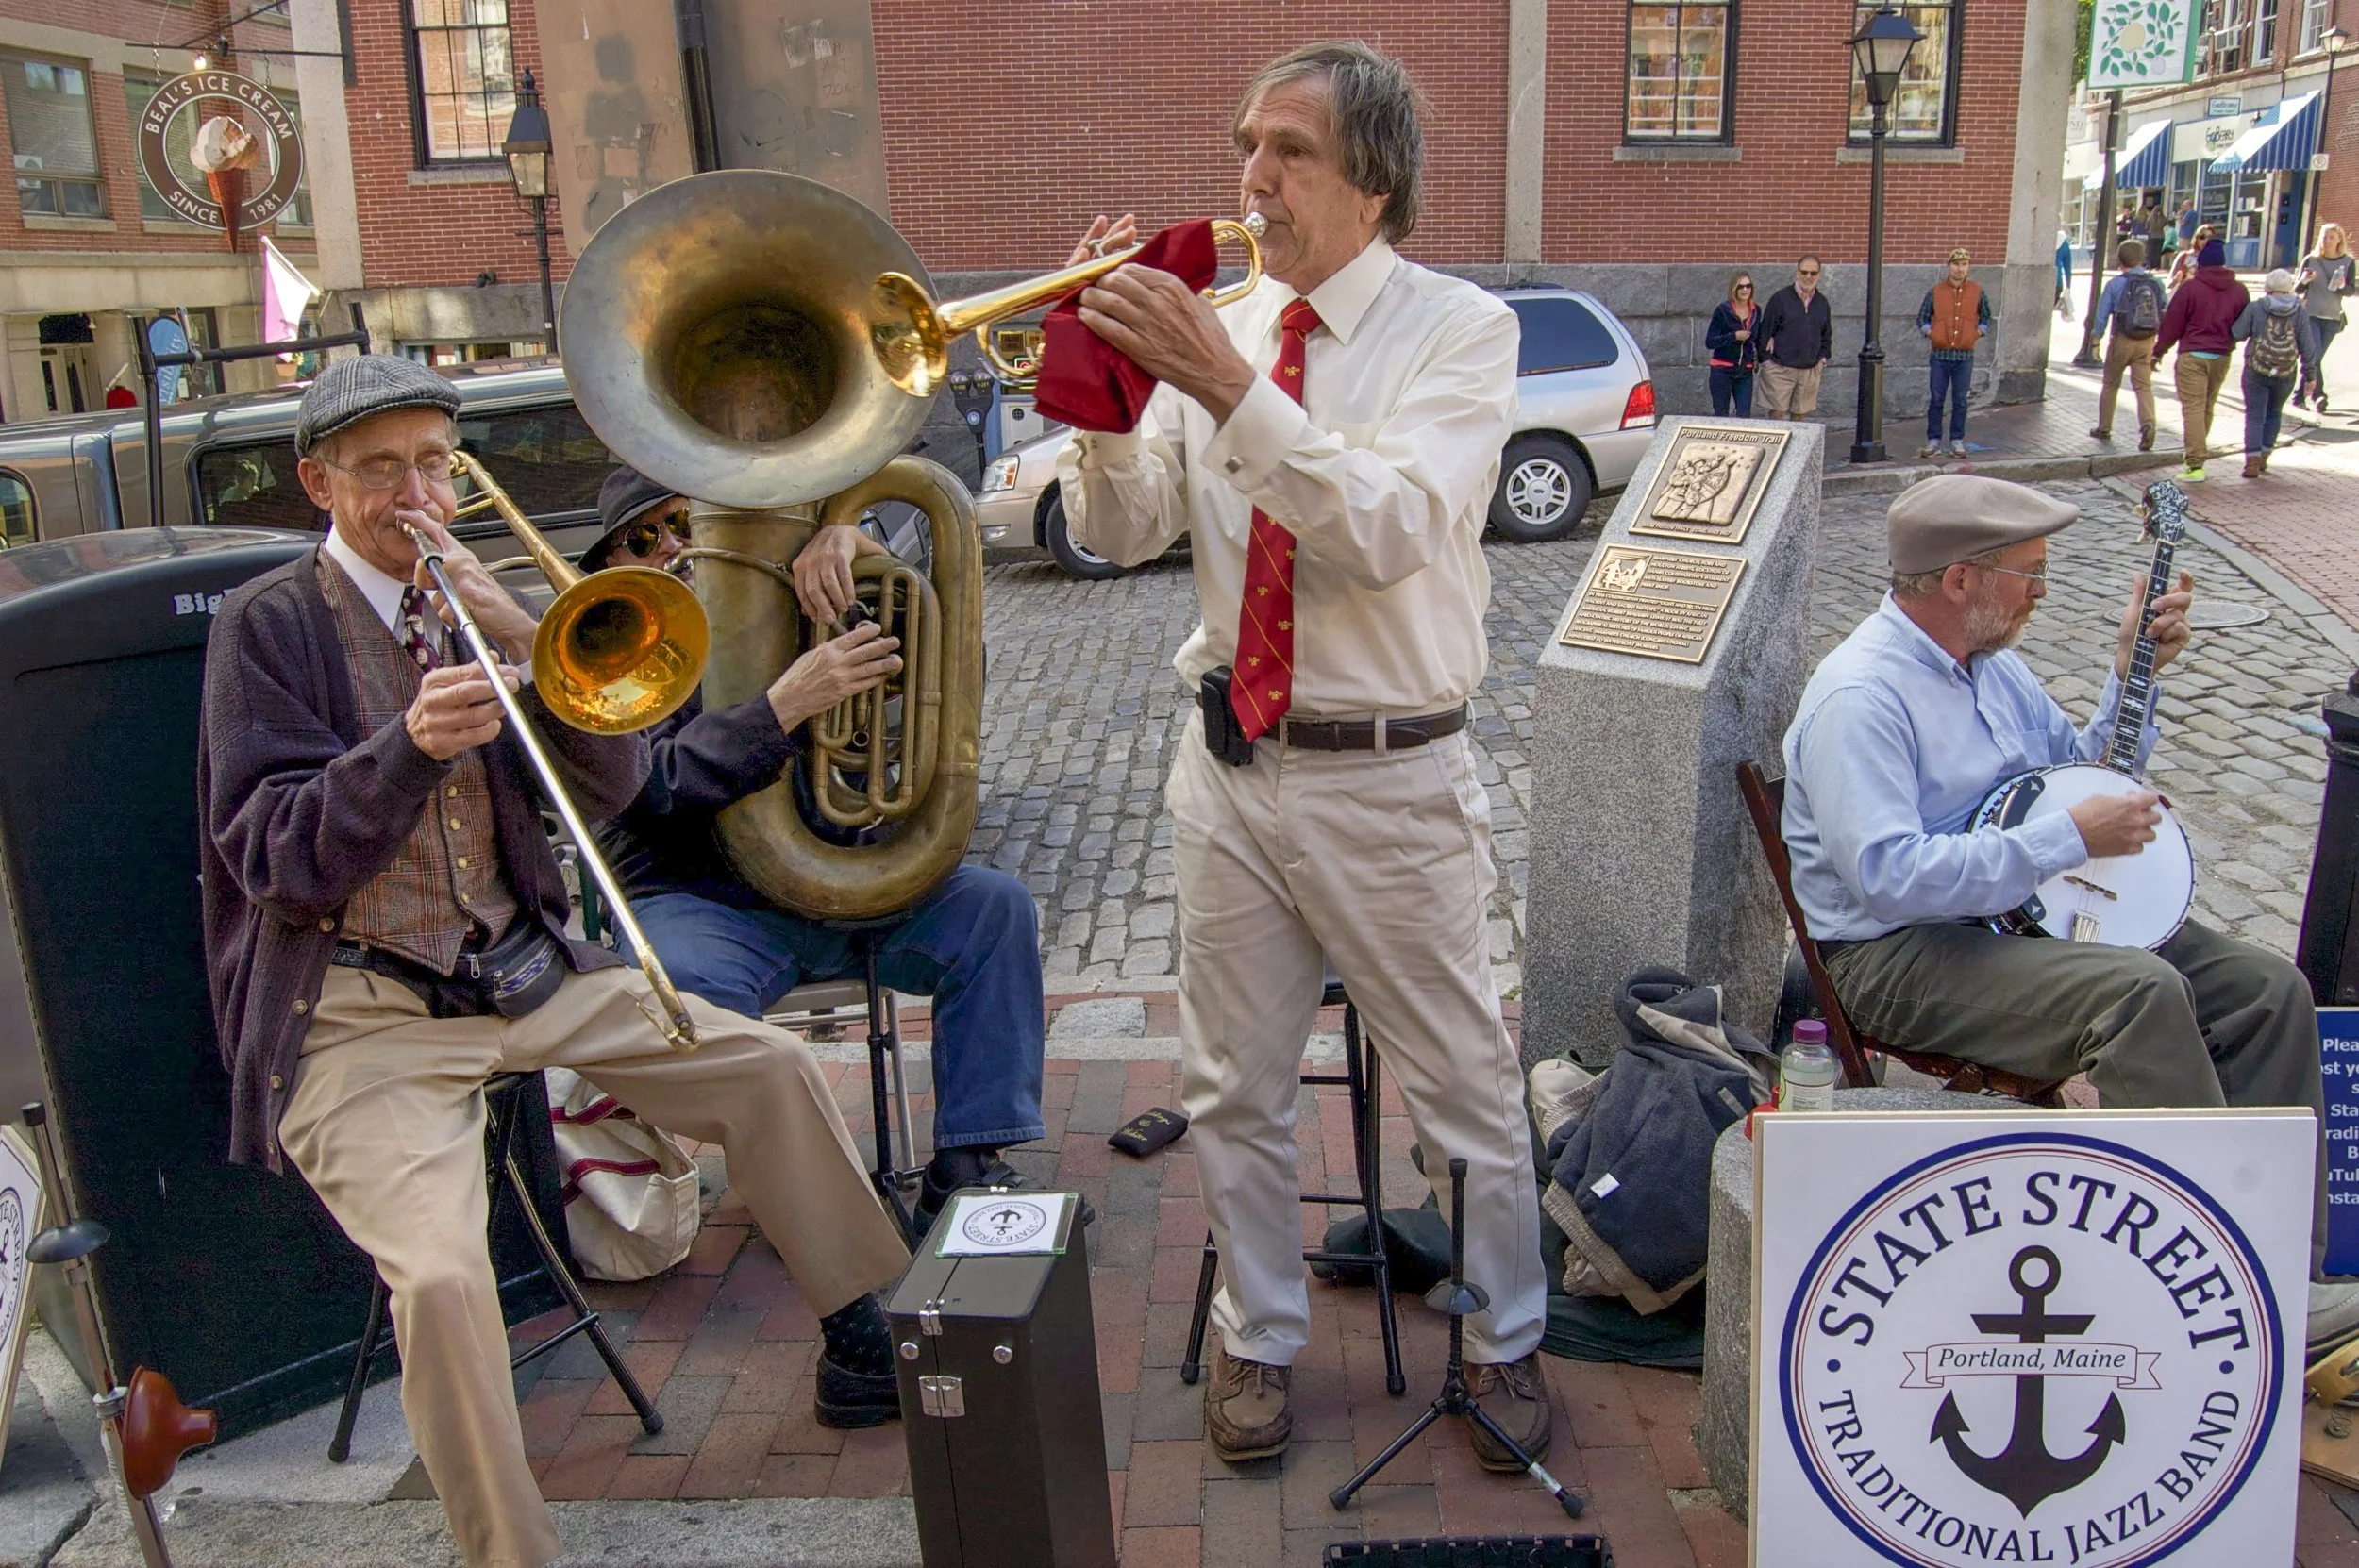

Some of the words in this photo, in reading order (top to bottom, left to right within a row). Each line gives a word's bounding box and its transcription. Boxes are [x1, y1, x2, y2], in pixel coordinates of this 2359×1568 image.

[145, 80, 193, 134] BEAL'S
[197, 75, 229, 92] ICE
[238, 83, 293, 139] CREAM
[169, 191, 218, 224] SINCE
[249, 192, 282, 220] 1981
[1680, 429, 1717, 441] Portland
[1719, 431, 1758, 442] Freedom
[1761, 434, 1782, 445] Trail
[174, 589, 236, 615] Big
[1818, 1176, 2002, 1348] STATE
[2022, 1171, 2250, 1352] STREET
[1938, 1347, 2046, 1372] Portland,
[2053, 1348, 2126, 1370] Maine
[1819, 1389, 2054, 1563] TRADITIONAL
[2064, 1492, 2166, 1565] JAZZ
[2155, 1390, 2241, 1503] BAND
